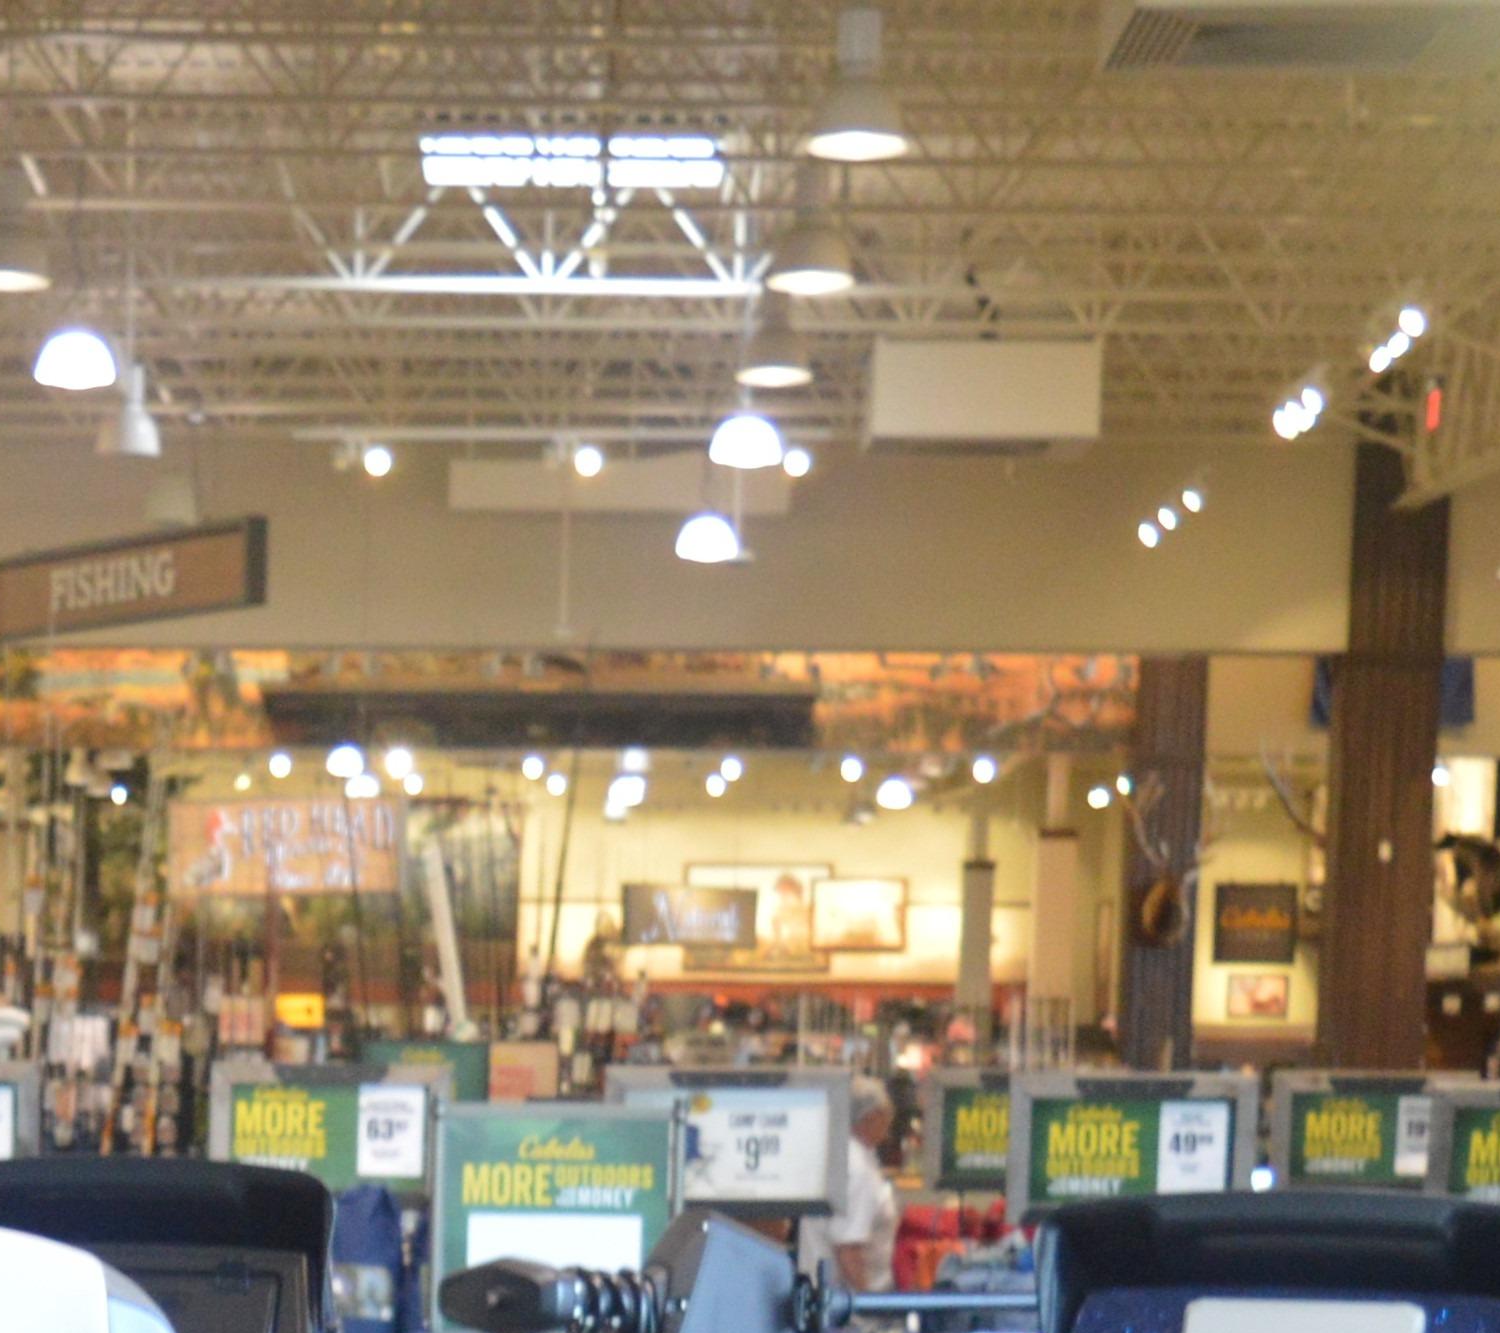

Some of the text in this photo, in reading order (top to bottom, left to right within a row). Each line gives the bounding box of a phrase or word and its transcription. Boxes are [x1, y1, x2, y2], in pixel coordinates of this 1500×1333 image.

[51, 550, 176, 611] FISHING
[235, 1100, 326, 1137] MORE
[956, 1106, 1008, 1138] MO
[1304, 1111, 1382, 1142] MORE
[1048, 1121, 1142, 1157] MORE
[461, 1163, 553, 1206] MORE
[554, 1163, 654, 1190] OUTDOORS
